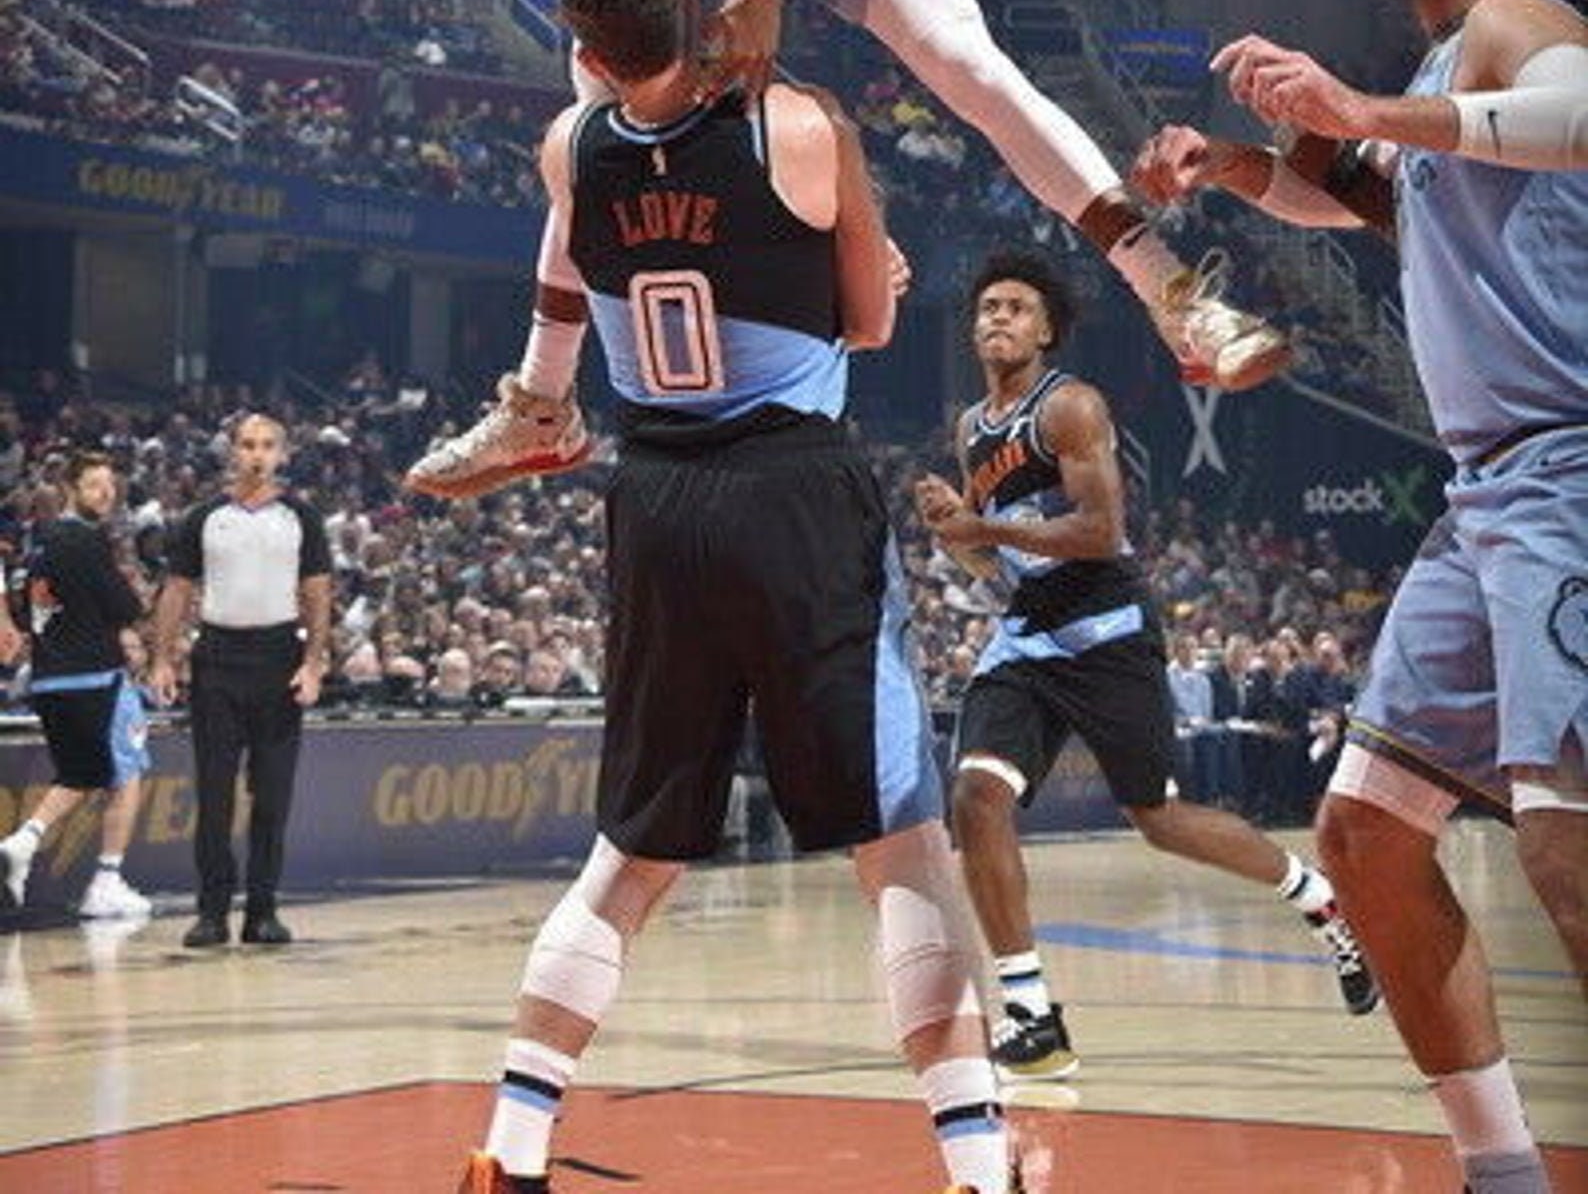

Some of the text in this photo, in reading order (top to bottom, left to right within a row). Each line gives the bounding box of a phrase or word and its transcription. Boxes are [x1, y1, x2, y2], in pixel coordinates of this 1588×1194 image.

[78, 158, 286, 219] GOODYEAR
[612, 190, 719, 248] LOVE
[629, 270, 724, 396] 0
